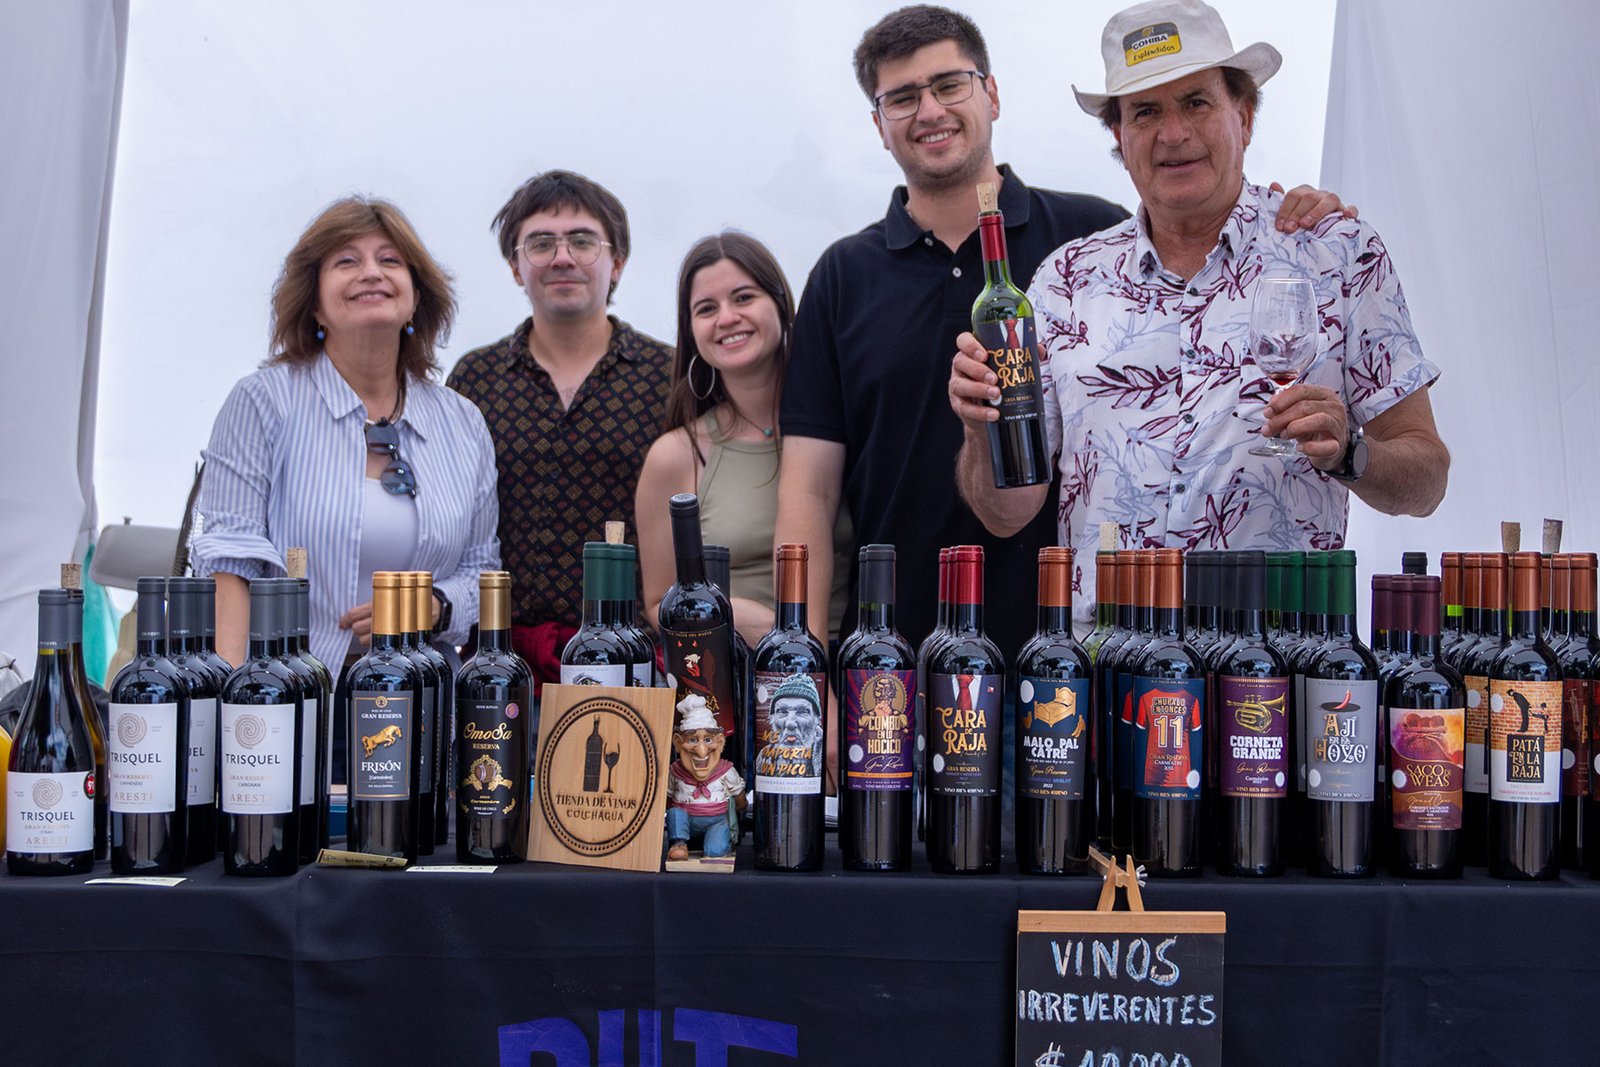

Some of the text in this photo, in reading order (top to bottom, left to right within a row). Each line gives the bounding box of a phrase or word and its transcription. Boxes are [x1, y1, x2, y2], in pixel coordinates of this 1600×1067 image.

[1132, 34, 1168, 50] COHIBA
[987, 347, 1032, 366] CARA
[998, 366, 1035, 389] RAJA
[868, 716, 900, 731] COMBO
[936, 707, 987, 728] CARA
[463, 722, 512, 740] OmoSa
[1154, 716, 1184, 748] 11
[1324, 713, 1357, 738] AJÍ
[877, 730, 893, 739] EN LO
[868, 740, 901, 754] HOCICO
[942, 730, 988, 754] RAJA
[1024, 736, 1078, 750] MALO PAL
[1230, 736, 1284, 748] CORNETA
[1512, 737, 1540, 752] PATÁ
[1032, 748, 1068, 759] CATRE
[1232, 748, 1282, 760] GRANDE
[1312, 738, 1366, 764] HOYO
[110, 752, 162, 766] TRISQUEL
[225, 753, 280, 768] TRISQUEL
[1509, 752, 1540, 766] EN LA
[361, 760, 402, 774] FRISÓN
[1406, 764, 1444, 776] SACO
[1512, 766, 1540, 778] RAJA
[1410, 774, 1450, 787] WEAS
[114, 791, 153, 801] ARESTI
[230, 794, 272, 803] ARESTI
[556, 794, 637, 810] TIENDA DE VINOS
[20, 811, 76, 823] TRISQUEL
[1050, 936, 1180, 987] VINOS
[1018, 990, 1217, 1026] IRREVERENTES
